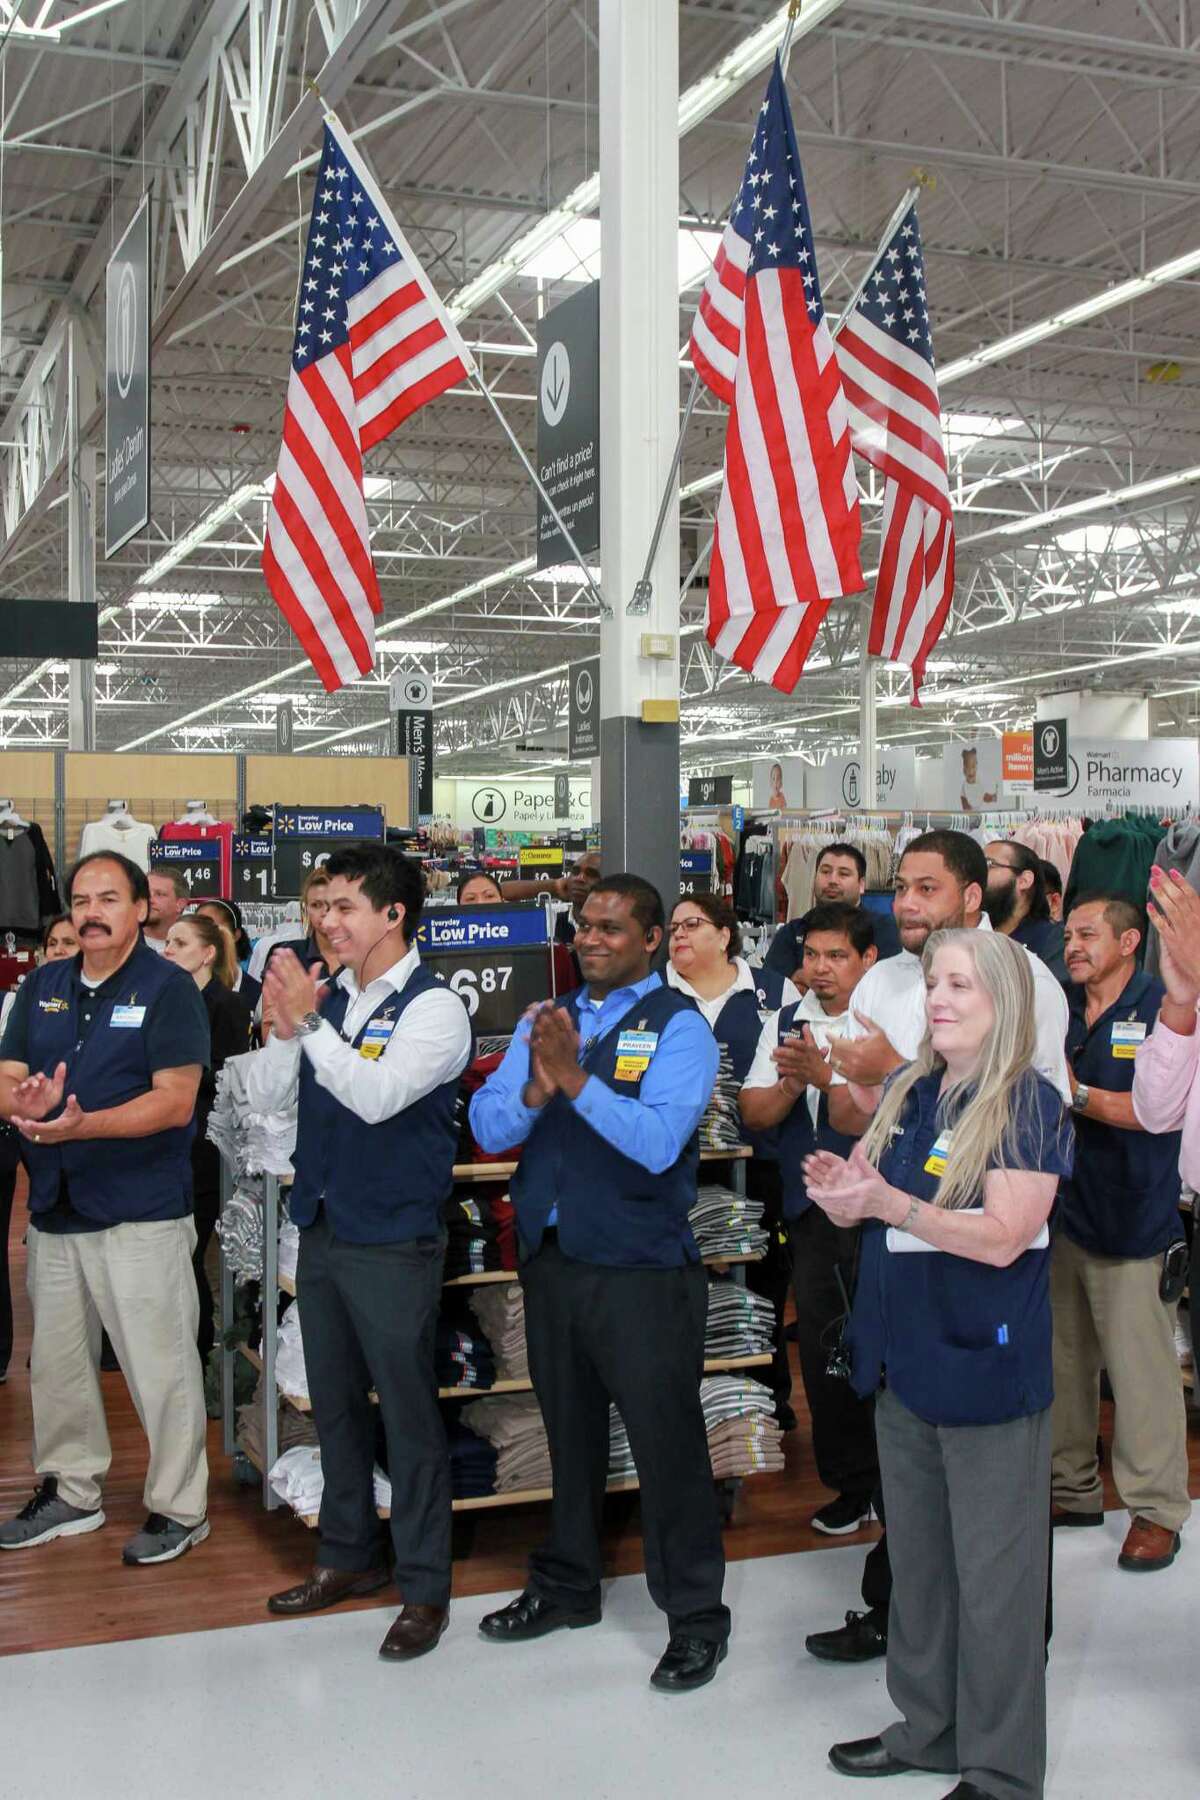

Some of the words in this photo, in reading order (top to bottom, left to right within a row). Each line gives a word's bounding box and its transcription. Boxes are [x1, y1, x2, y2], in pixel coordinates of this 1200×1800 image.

[540, 461, 557, 482] Can't
[556, 452, 569, 474] find
[569, 455, 574, 469] a
[574, 441, 594, 469] price?
[413, 715, 426, 754] Men's
[1086, 751, 1112, 759] Walmart
[876, 762, 897, 791] aby
[1086, 760, 1184, 789] Pharmacy
[1087, 786, 1132, 798] Farmacia
[513, 790, 556, 811] Pape
[297, 819, 323, 832] Low
[324, 819, 354, 832] Price
[164, 848, 181, 857] Low
[182, 848, 202, 857] Price
[250, 844, 270, 855] Low
[430, 918, 461, 928] Everyday
[431, 926, 466, 942] Low
[467, 922, 509, 940] Price
